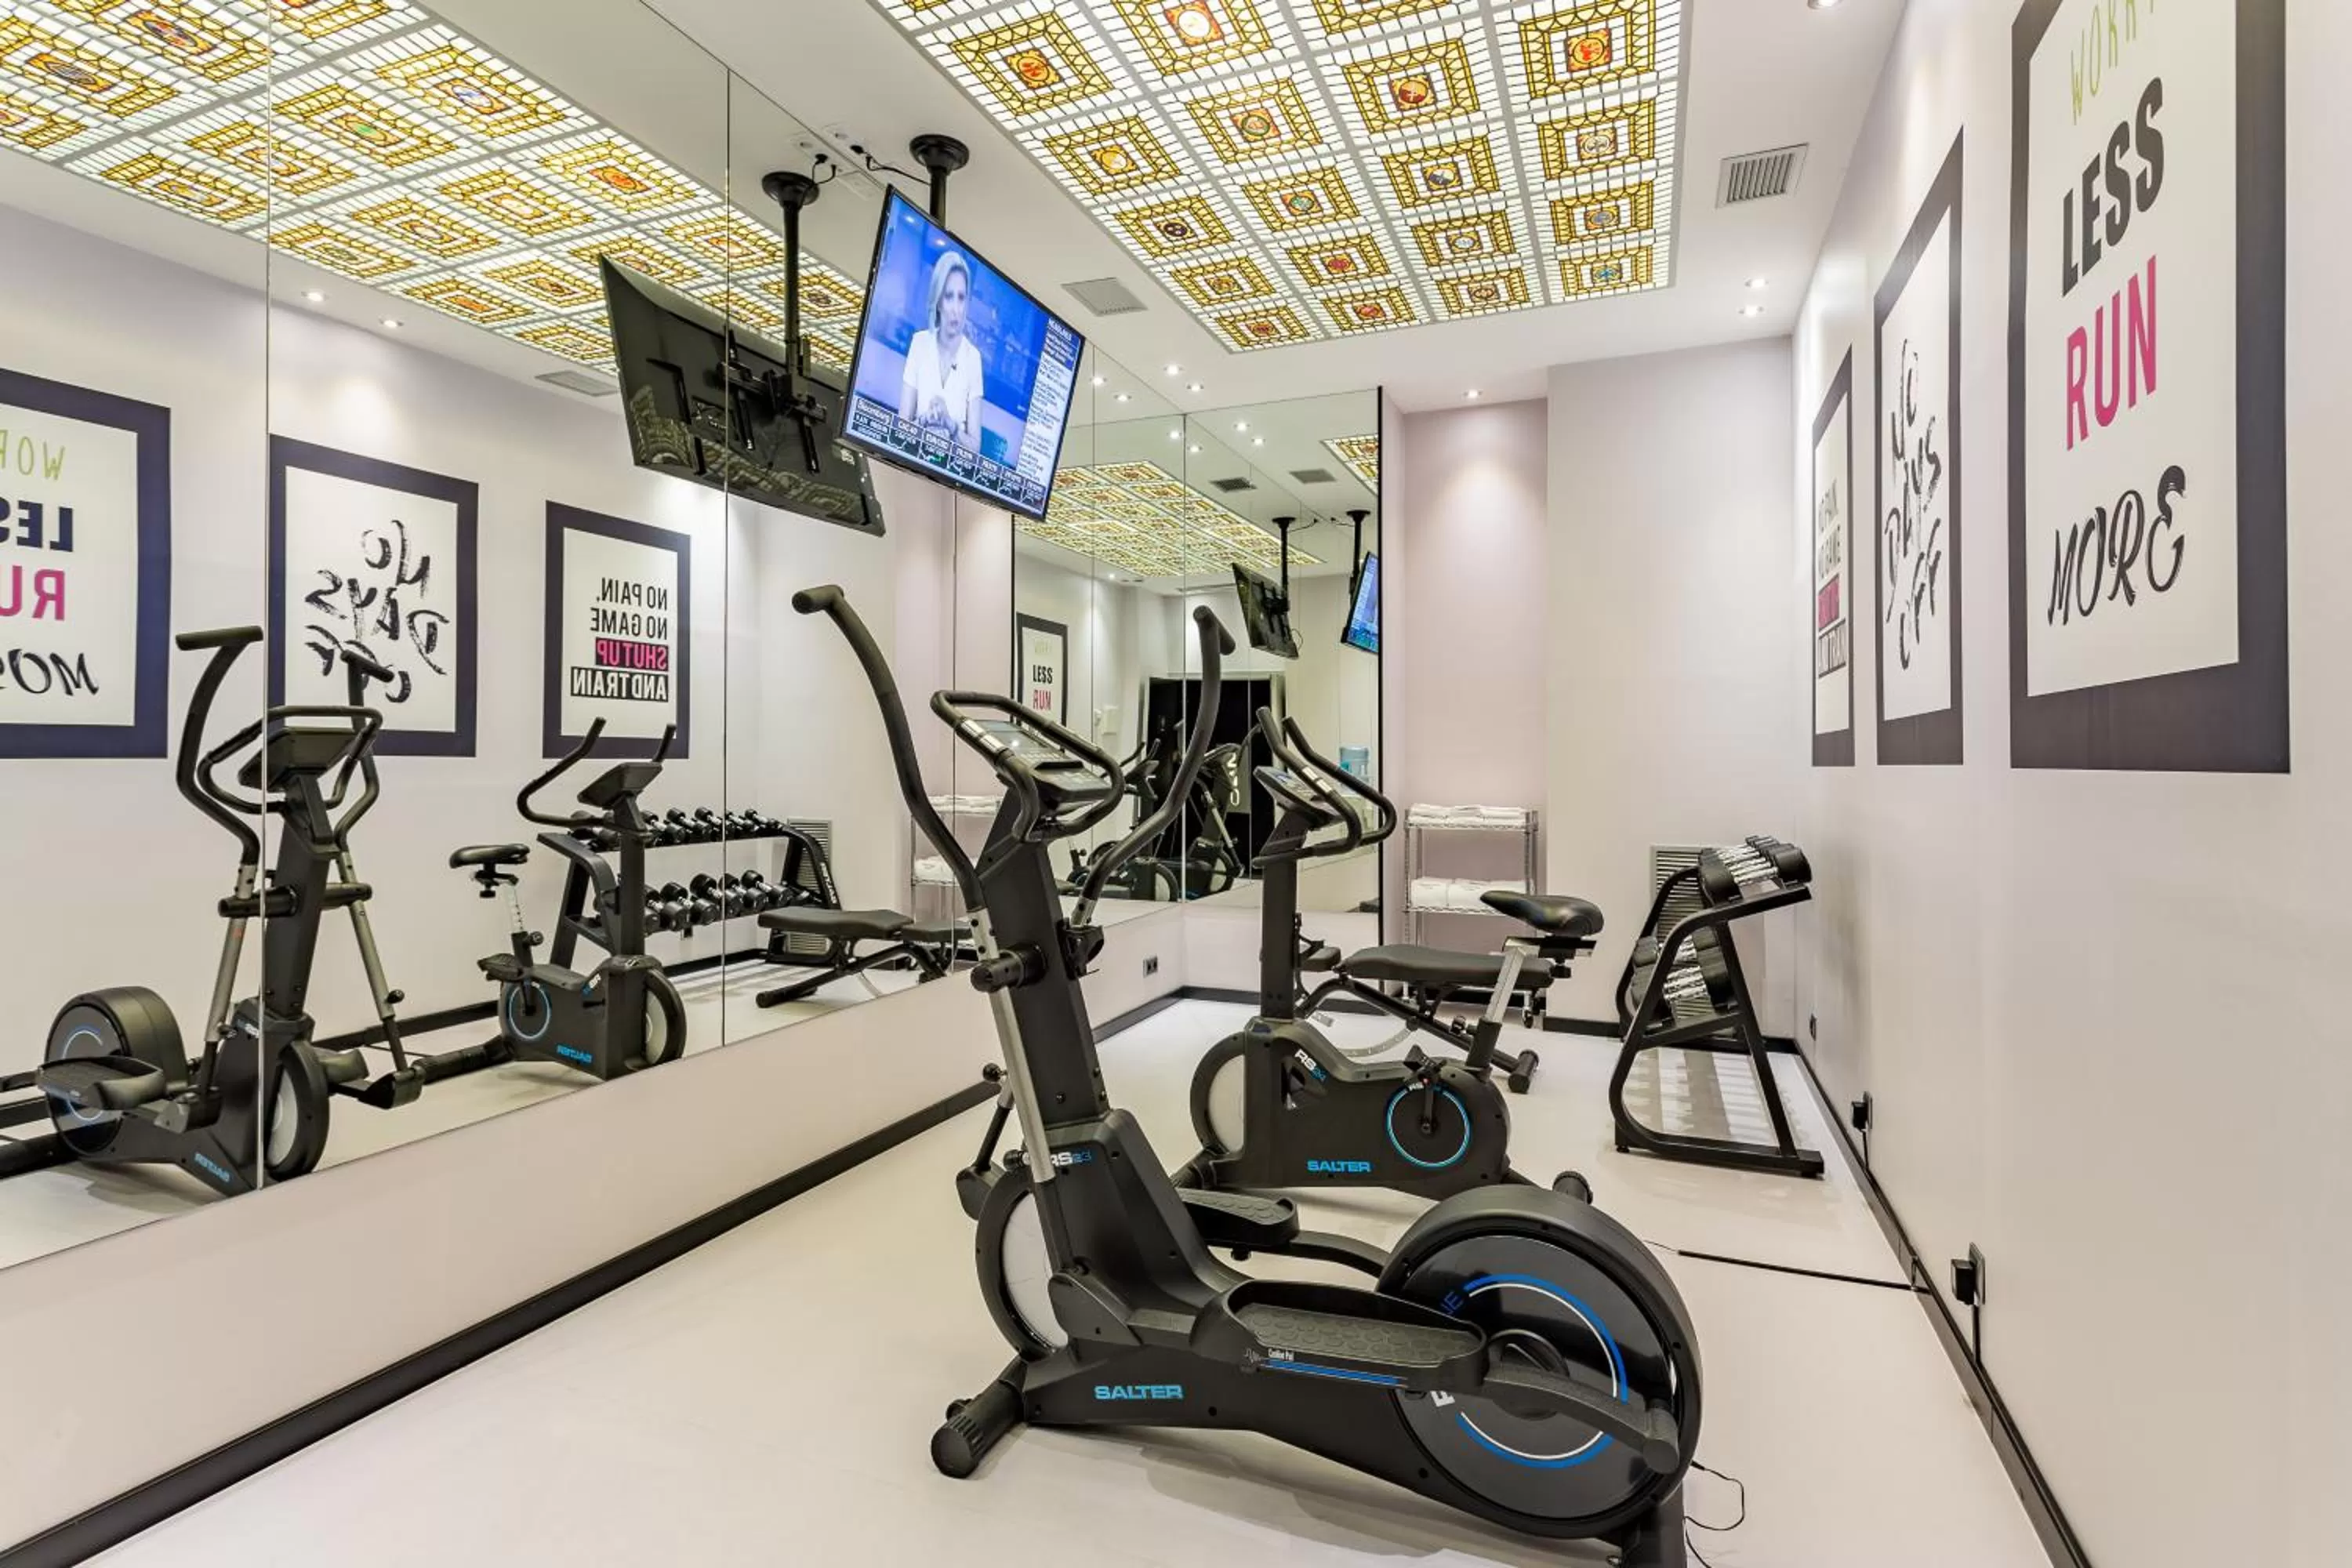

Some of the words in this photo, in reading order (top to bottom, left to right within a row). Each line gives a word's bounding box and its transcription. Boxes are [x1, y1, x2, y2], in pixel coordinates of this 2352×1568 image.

[2062, 76, 2165, 297] LESS
[2067, 255, 2156, 452] RUN
[2047, 465, 2185, 626] MORE
[1033, 664, 1053, 684] LESS
[1033, 689, 1051, 710] RUN
[1307, 1160, 1371, 1173] SALTER
[1094, 1385, 1184, 1399] SALTER
